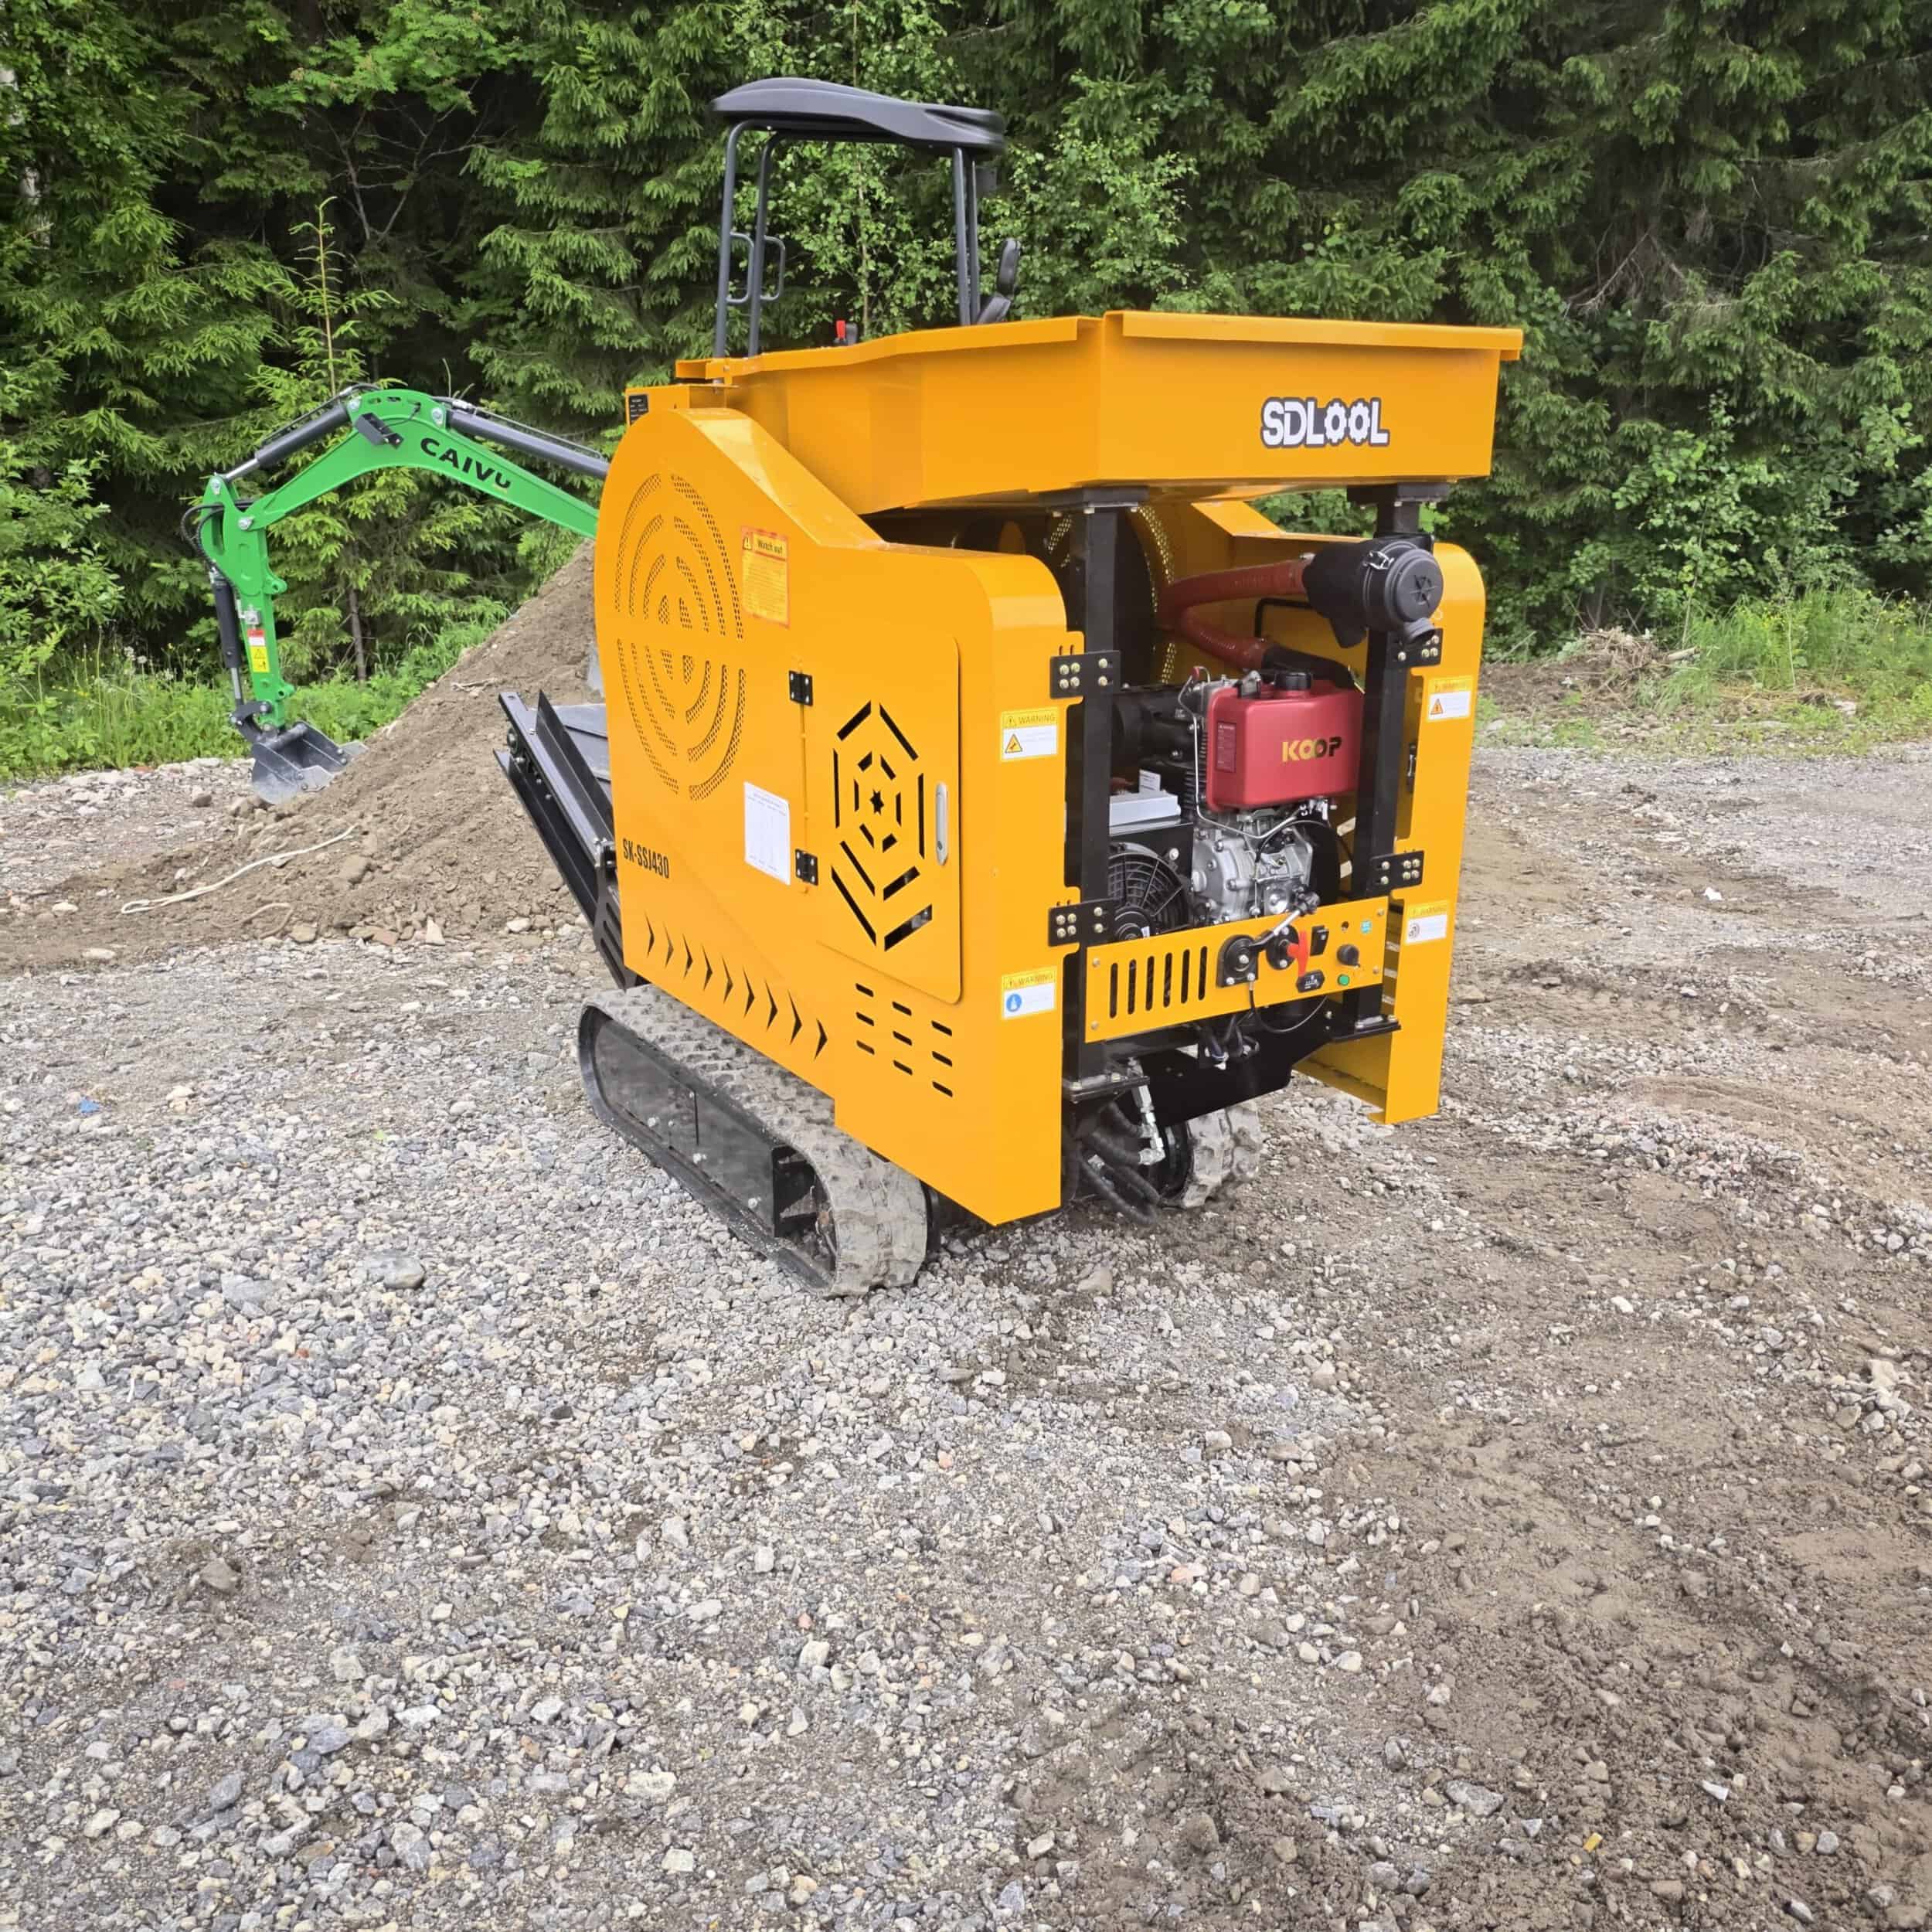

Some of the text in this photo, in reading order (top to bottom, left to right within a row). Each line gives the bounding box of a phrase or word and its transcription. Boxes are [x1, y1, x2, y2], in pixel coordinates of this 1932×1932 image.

[1262, 398, 1389, 447] SDLOOL
[1019, 713, 1056, 724] WARNING
[1282, 736, 1342, 762] KOOP
